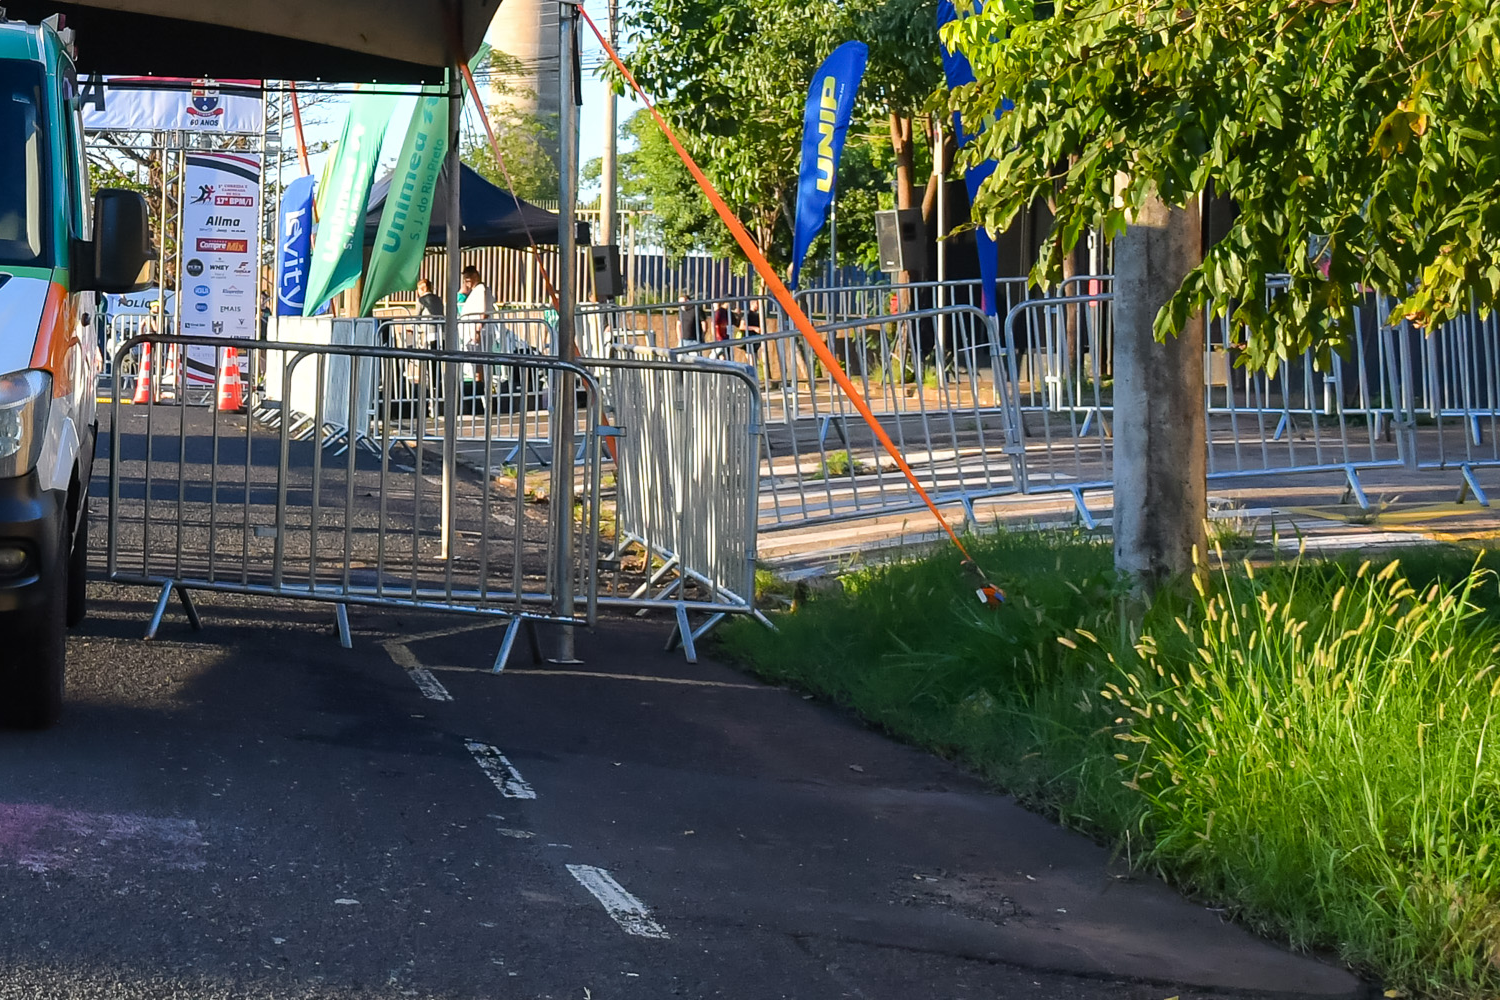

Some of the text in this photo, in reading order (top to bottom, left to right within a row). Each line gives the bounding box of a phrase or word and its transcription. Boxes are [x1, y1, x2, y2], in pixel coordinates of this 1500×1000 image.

[200, 119, 219, 127] ANOS
[816, 75, 837, 193] UNIP
[427, 138, 445, 171] Preto
[382, 131, 428, 253] Unimed
[421, 174, 434, 194] Rio
[416, 197, 429, 213] do
[205, 215, 241, 227] Allma
[226, 242, 245, 252] Mix
[278, 207, 305, 308] Levity
